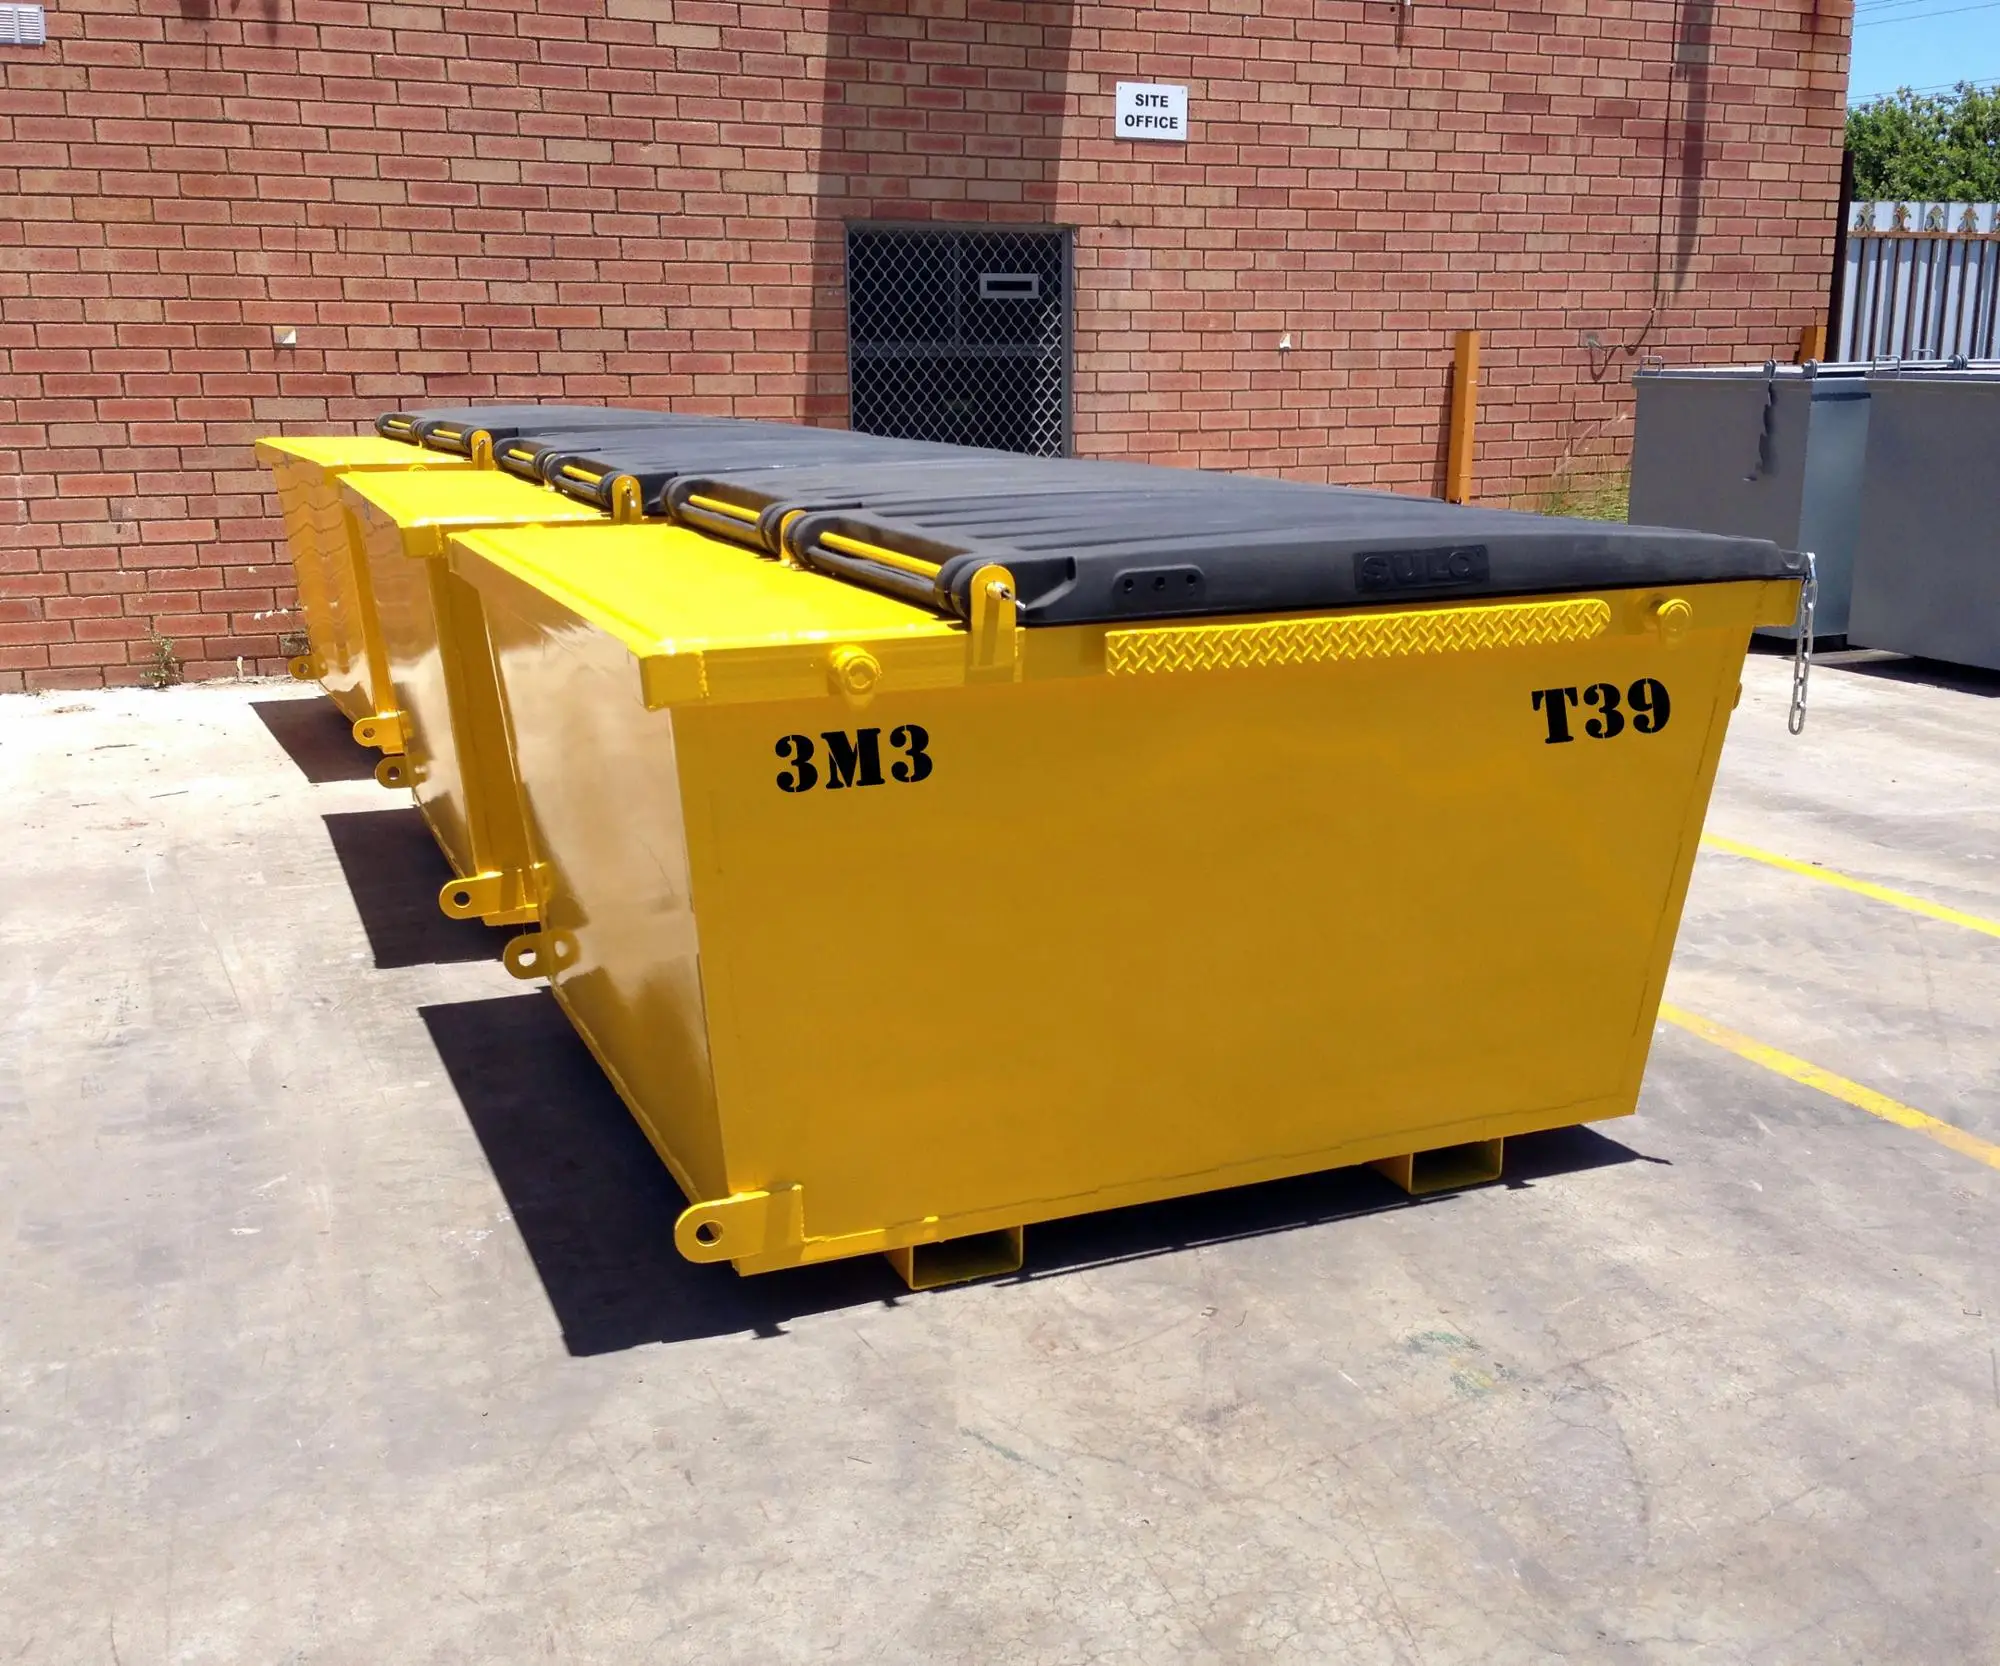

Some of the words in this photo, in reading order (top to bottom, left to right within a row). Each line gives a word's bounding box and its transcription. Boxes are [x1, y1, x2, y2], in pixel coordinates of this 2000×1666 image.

[1135, 93, 1169, 108] SITE
[1124, 114, 1178, 129] OFFICE
[1362, 551, 1476, 586] SULO
[1531, 678, 1671, 744] T39
[774, 724, 933, 793] 3M3
